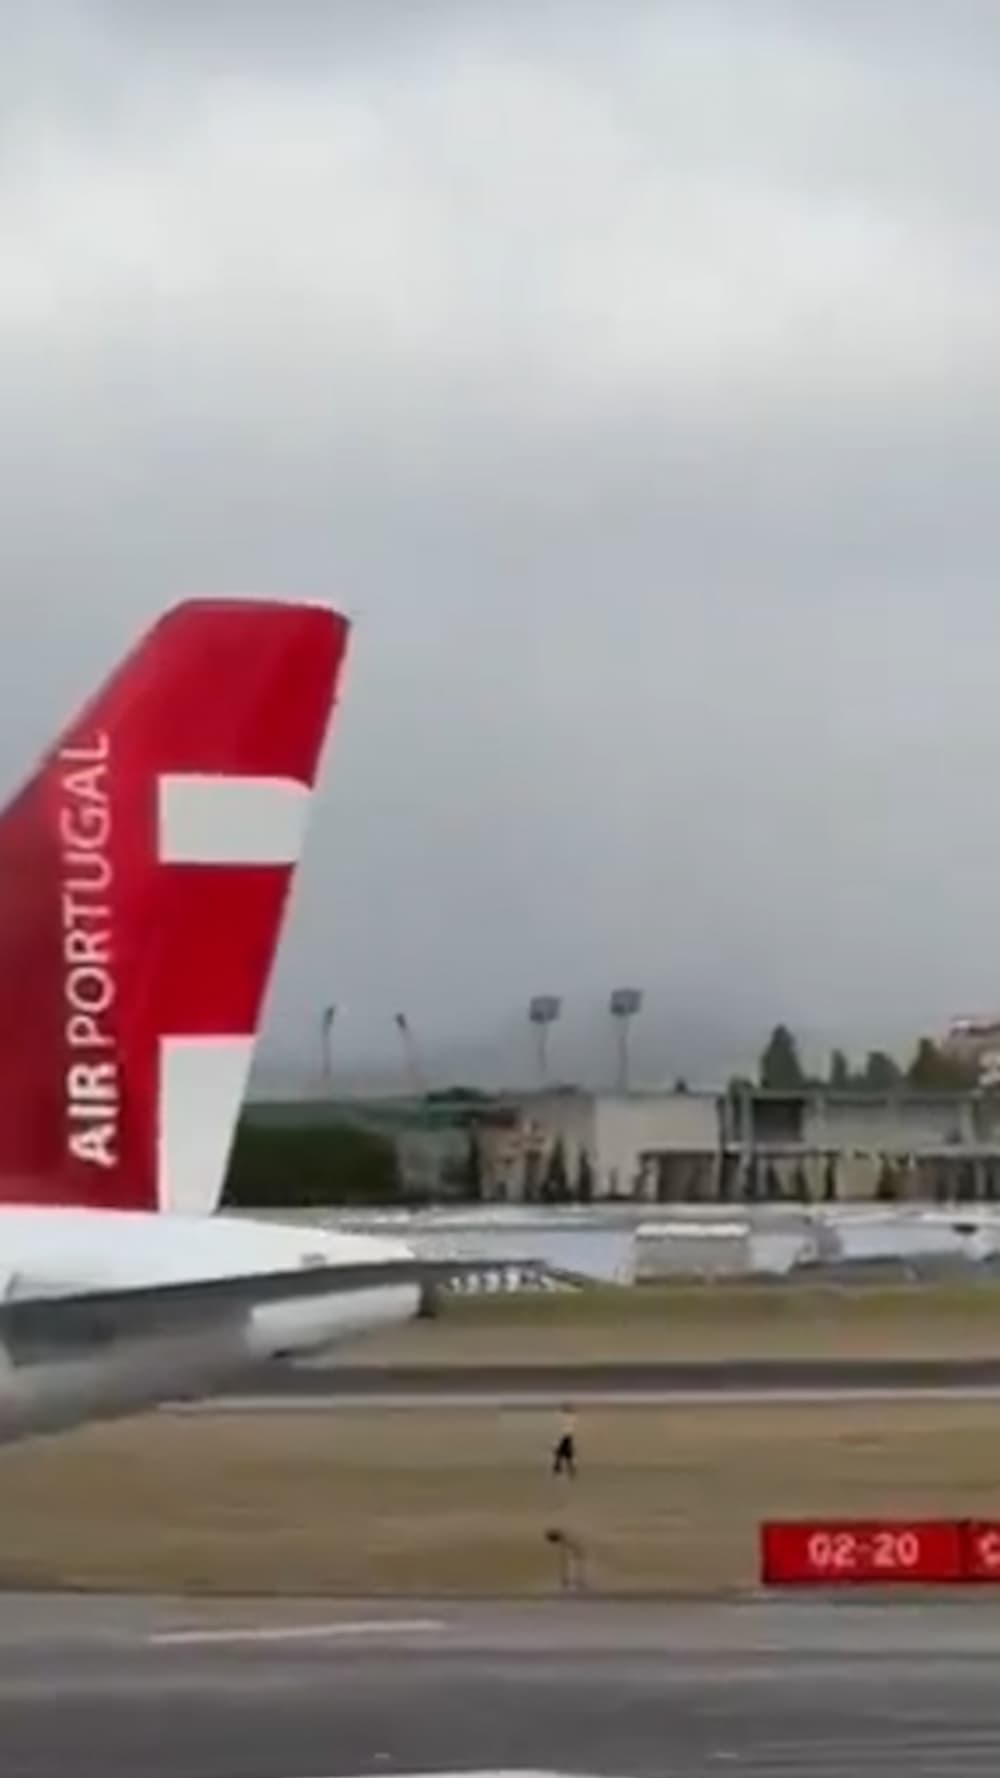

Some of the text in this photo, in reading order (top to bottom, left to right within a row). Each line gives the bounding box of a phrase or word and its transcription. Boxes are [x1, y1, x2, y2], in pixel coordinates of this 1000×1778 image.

[60, 731, 118, 1168] AIR PORTUGAL
[807, 1531, 919, 1569] 02-20
